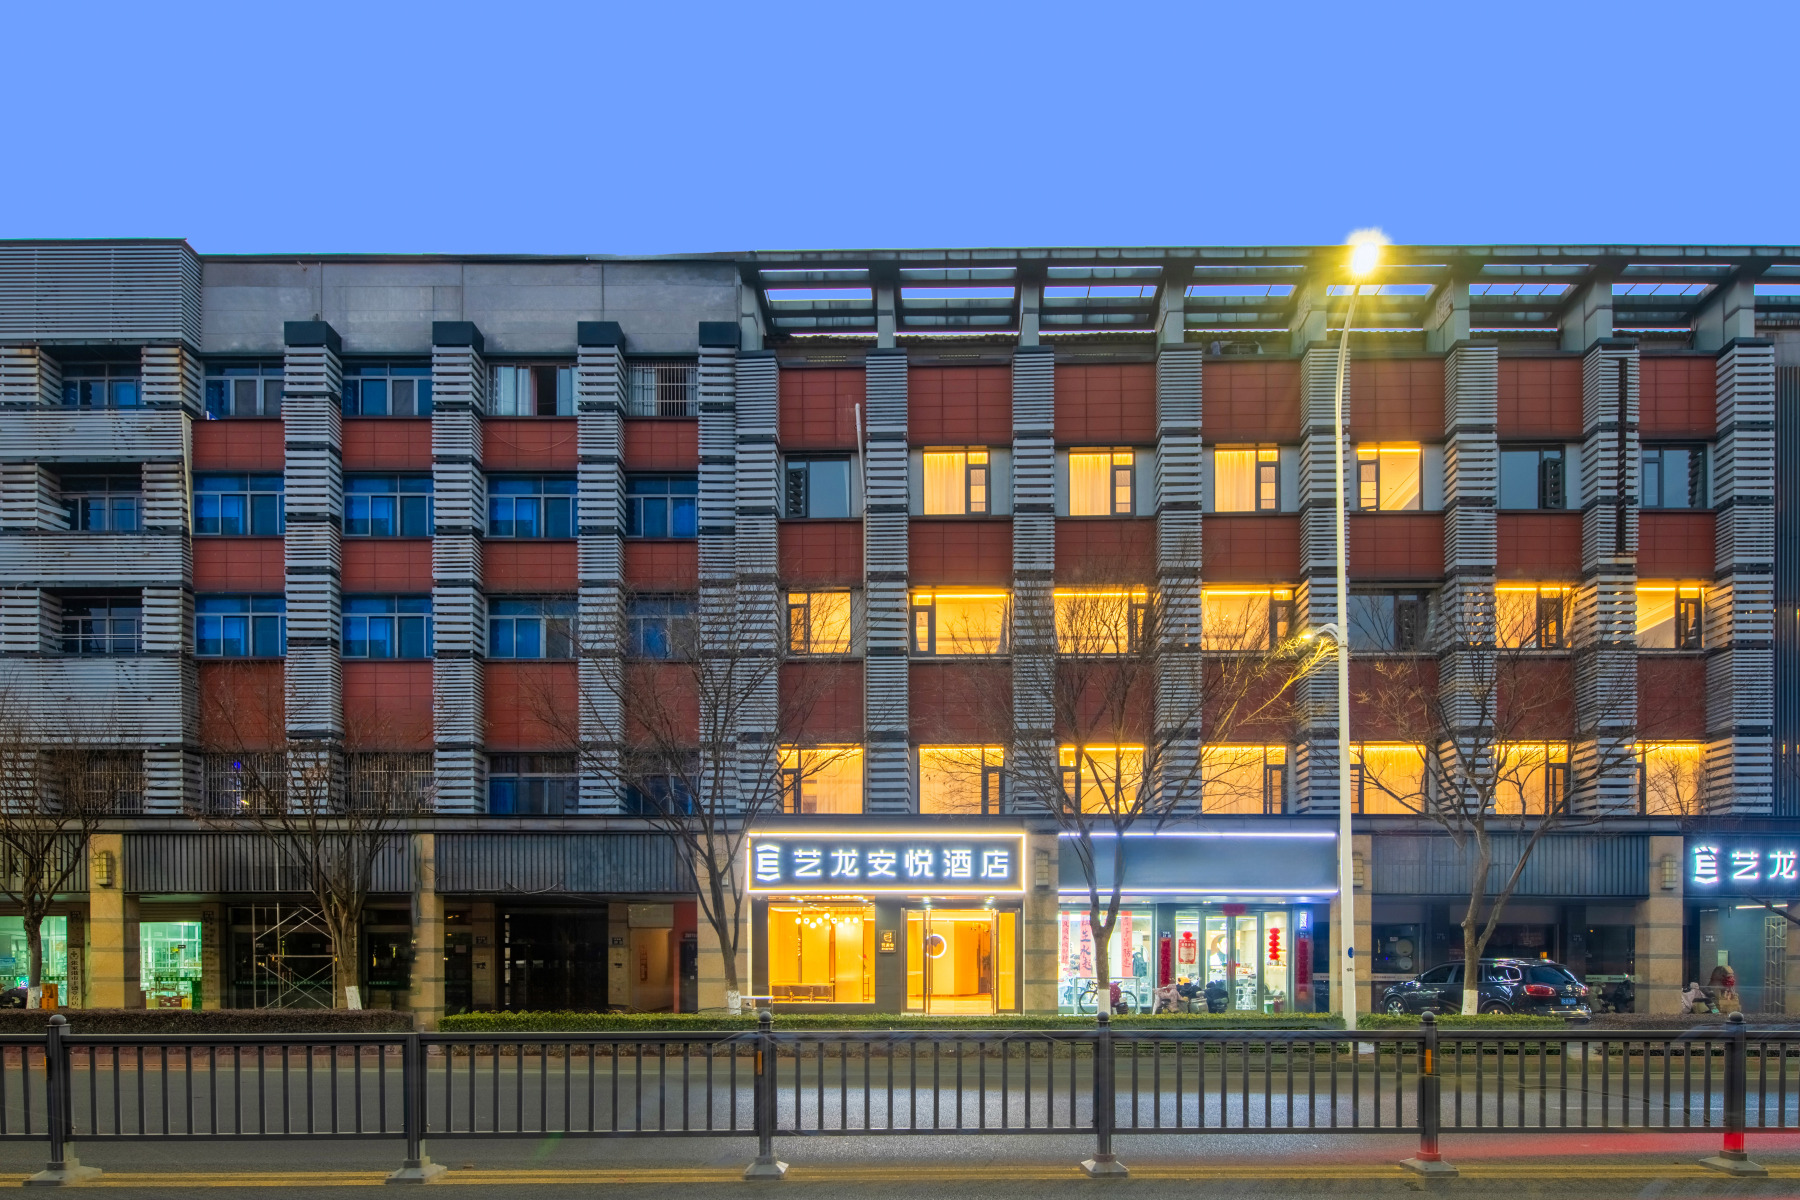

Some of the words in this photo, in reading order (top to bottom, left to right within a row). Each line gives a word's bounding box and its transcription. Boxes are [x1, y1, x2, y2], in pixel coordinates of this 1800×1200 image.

[794, 849, 1009, 878] 艺龙安悦酒店
[1731, 851, 1797, 879] 艺龙
